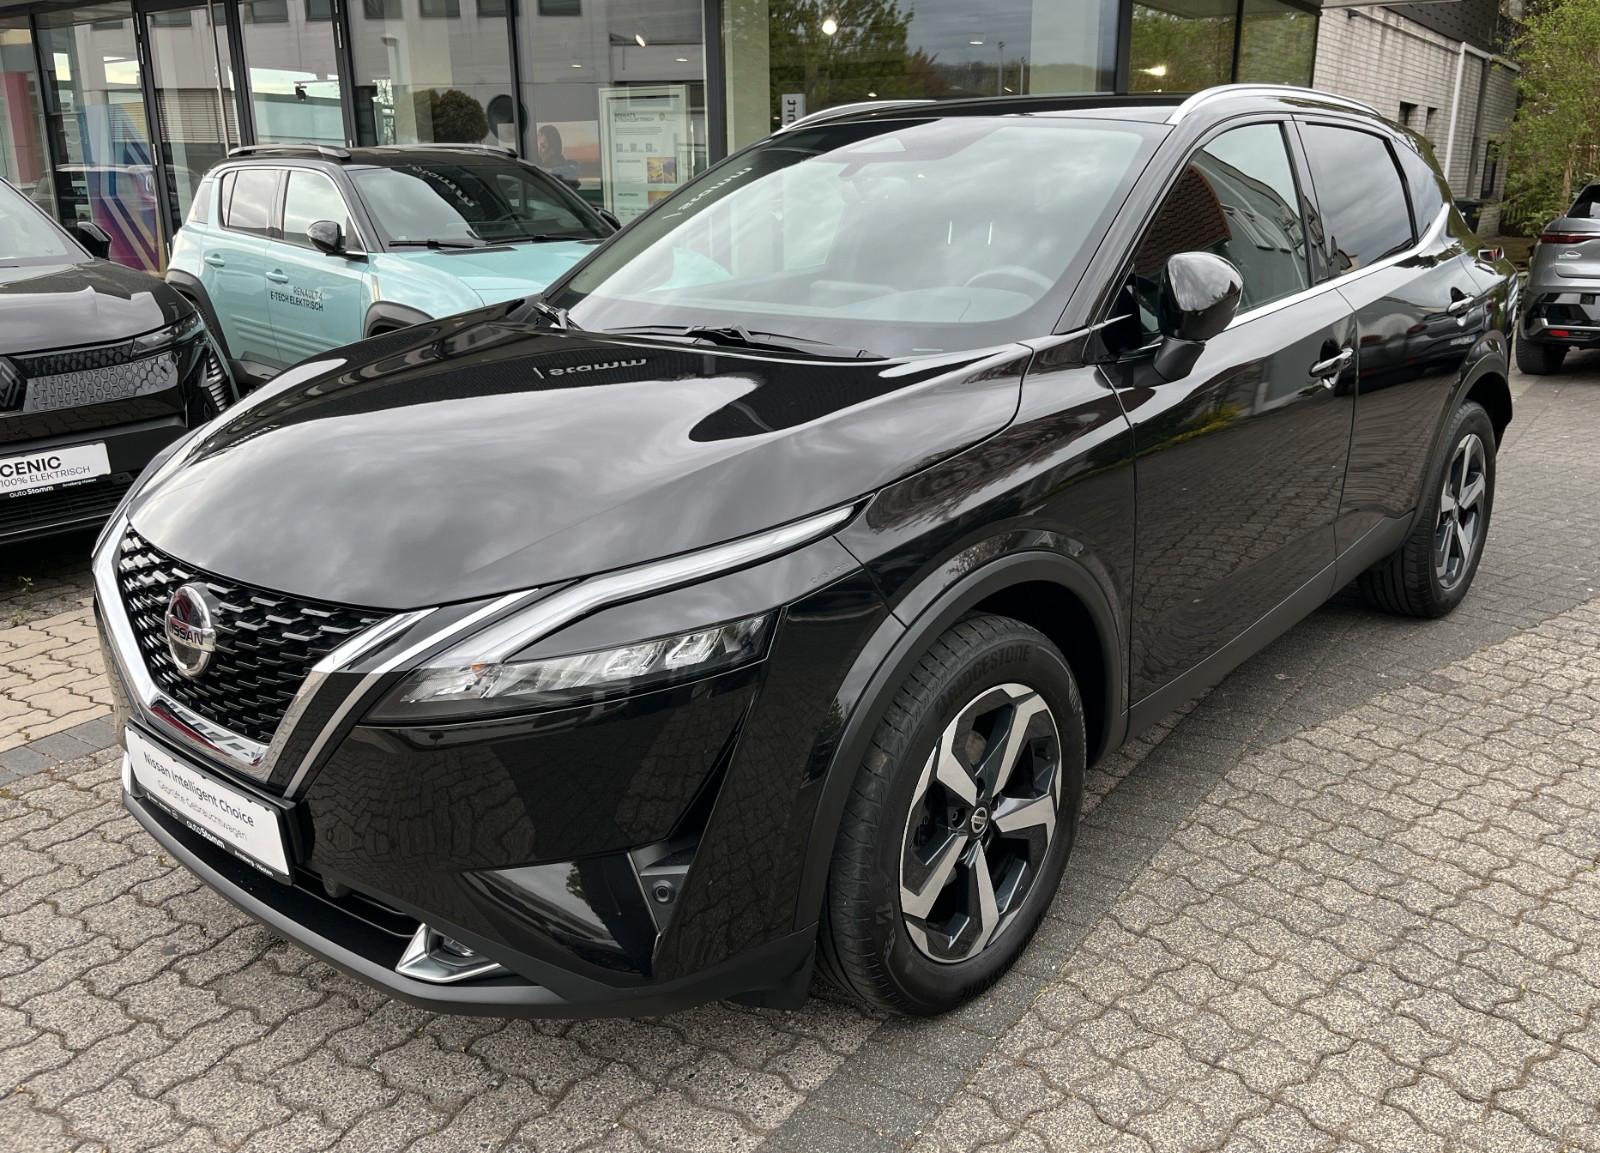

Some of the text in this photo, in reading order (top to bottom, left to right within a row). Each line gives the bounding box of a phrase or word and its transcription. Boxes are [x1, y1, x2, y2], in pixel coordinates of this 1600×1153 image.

[289, 295, 324, 312] ELEKTRISCH
[0, 456, 62, 477] CENIC
[1, 477, 28, 488] 100%
[29, 465, 91, 483] ELEKTRISCH
[169, 622, 203, 646] NISSAN
[143, 751, 171, 778] Nissan
[172, 769, 219, 809] Intelligent
[219, 798, 255, 828] Choice
